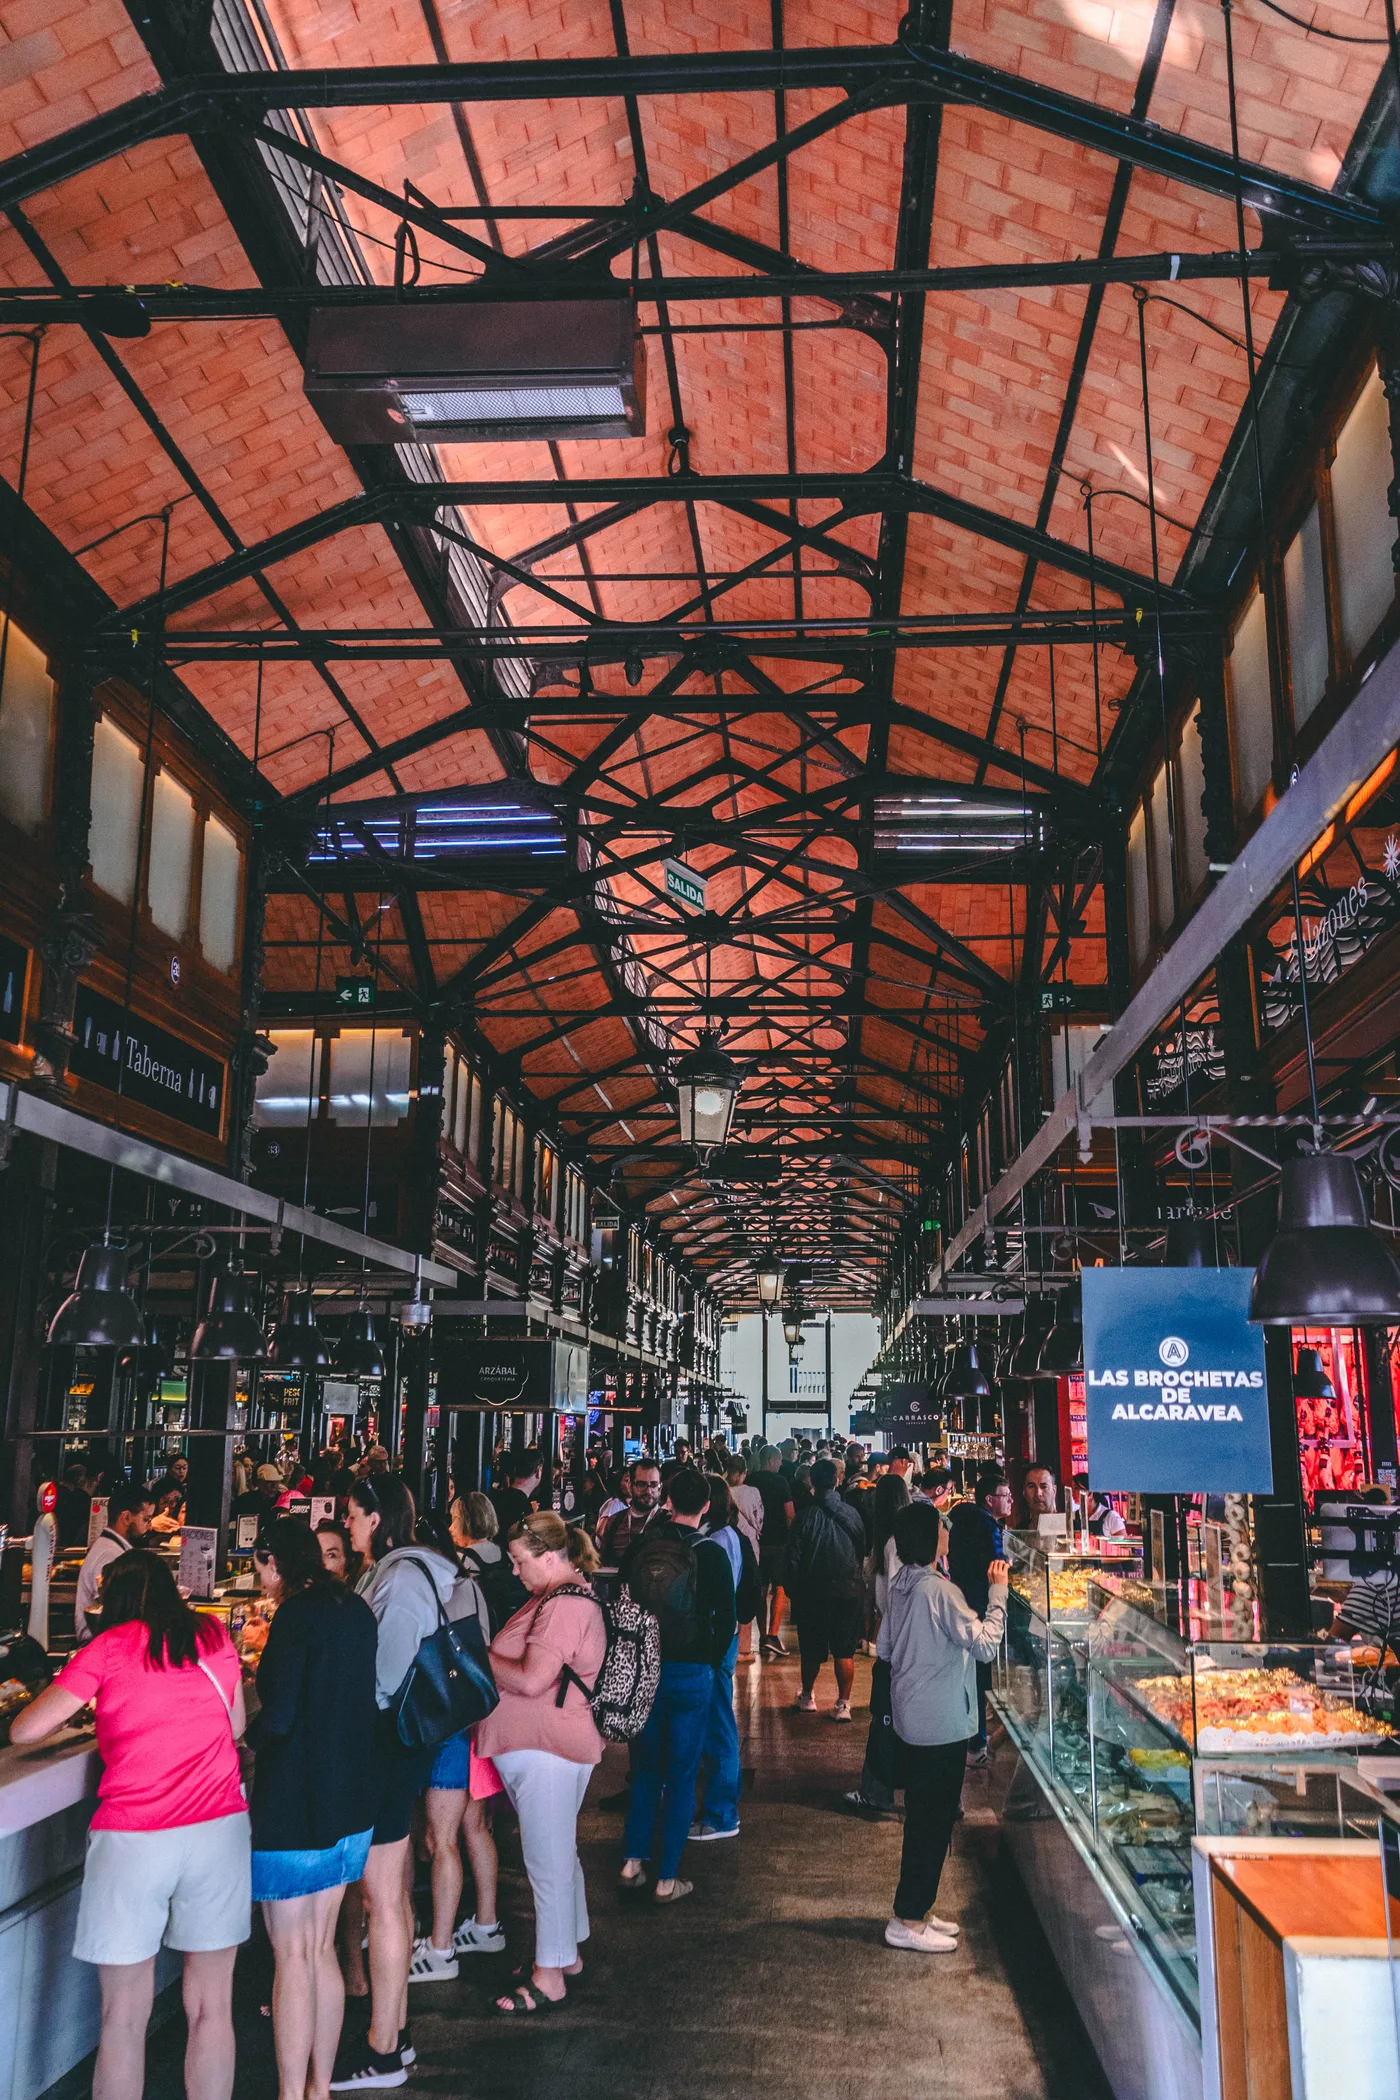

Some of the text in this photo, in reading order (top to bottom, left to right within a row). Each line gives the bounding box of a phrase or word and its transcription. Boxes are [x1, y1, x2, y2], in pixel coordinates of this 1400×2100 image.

[667, 873, 704, 906] SALIDA
[126, 1036, 182, 1094] Taberna
[1088, 1370, 1264, 1388] LAS BROCHETAS
[1161, 1388, 1191, 1404] DE
[1111, 1404, 1243, 1421] ALCARAVEA
